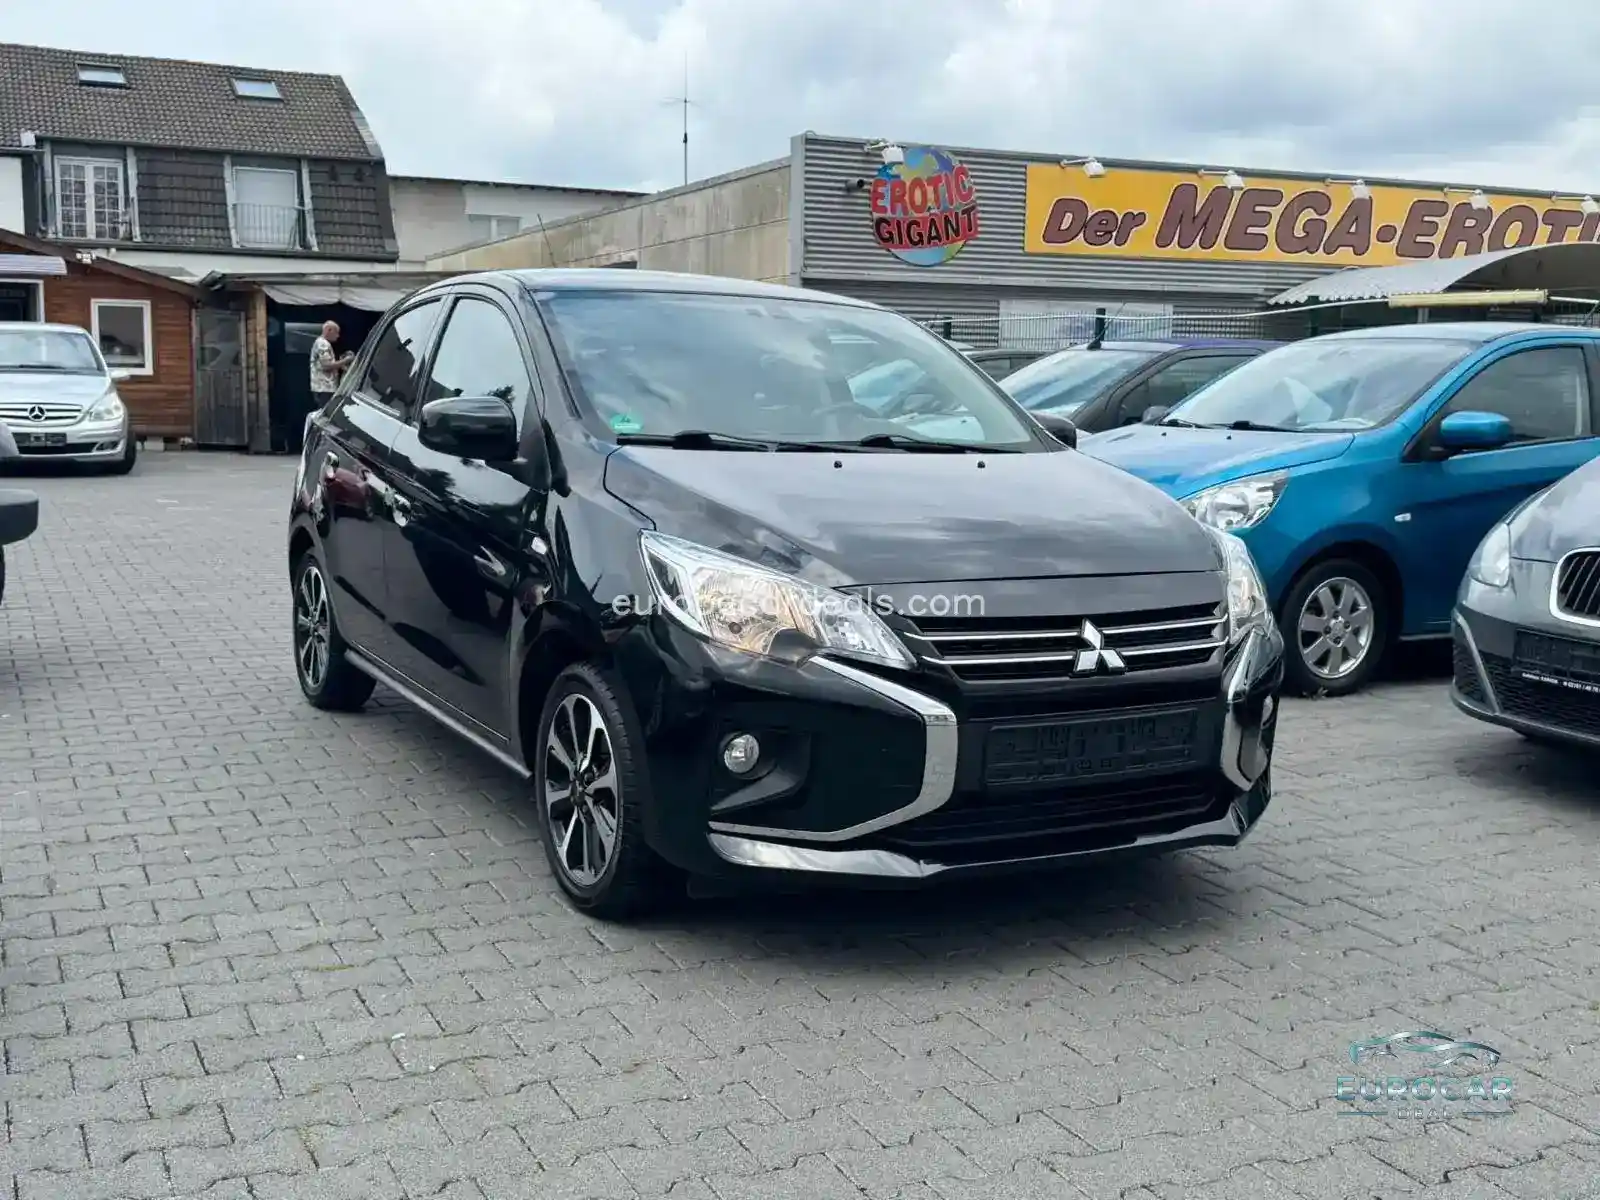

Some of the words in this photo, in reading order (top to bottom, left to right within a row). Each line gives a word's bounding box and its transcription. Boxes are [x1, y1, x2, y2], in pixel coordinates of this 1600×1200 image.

[871, 164, 976, 215] EROTIC
[875, 203, 978, 246] GIGANT
[1042, 197, 1146, 247] Der
